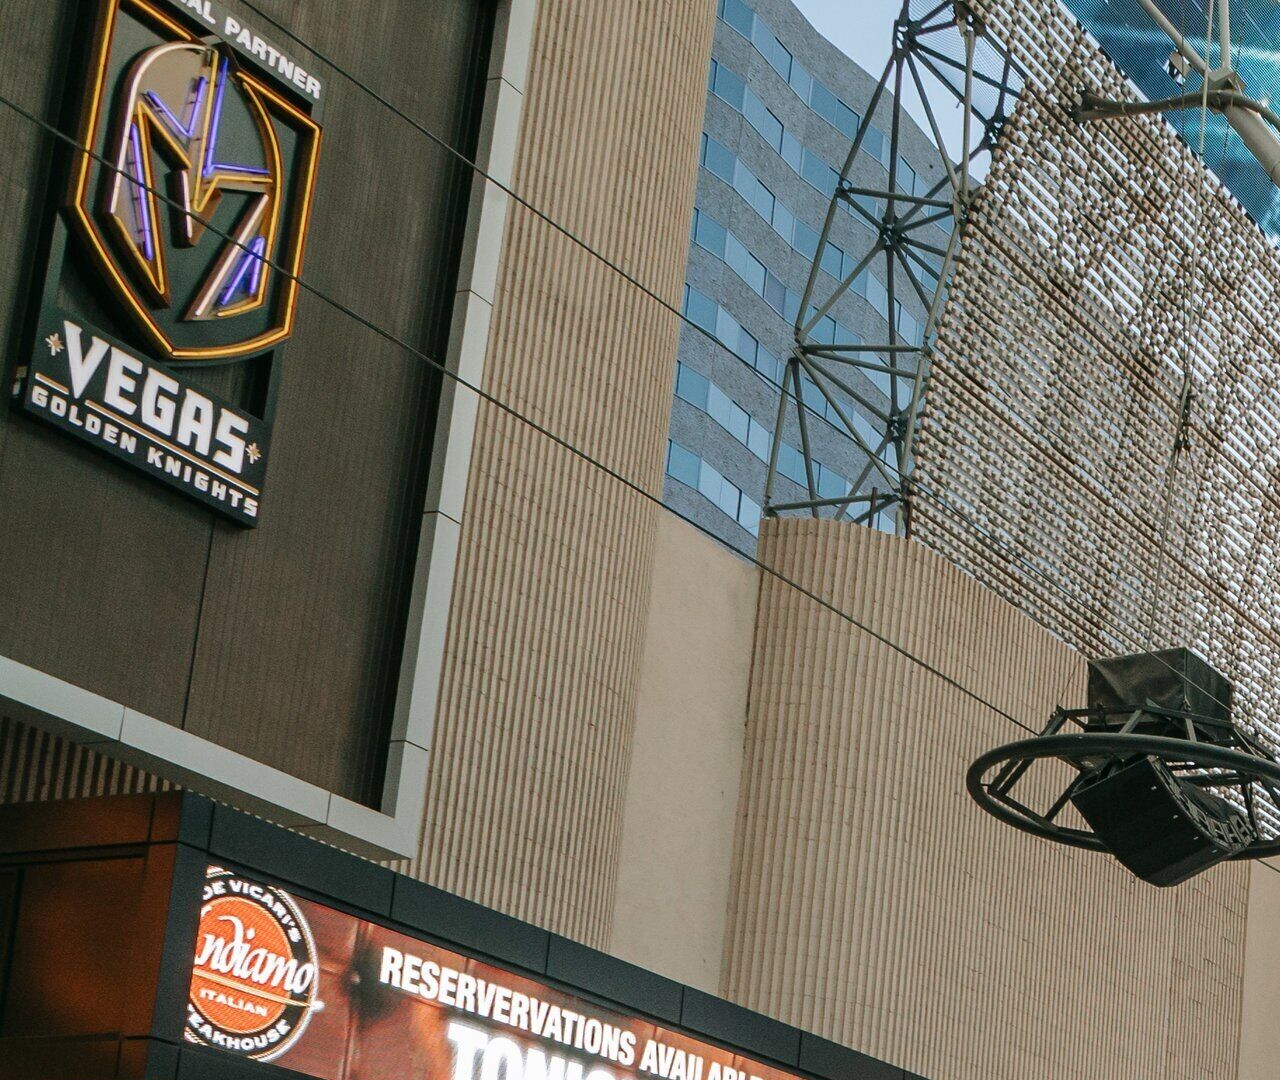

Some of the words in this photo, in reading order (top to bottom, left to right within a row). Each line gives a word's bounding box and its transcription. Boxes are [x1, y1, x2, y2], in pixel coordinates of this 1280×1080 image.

[224, 16, 322, 99] PARTNER
[63, 320, 250, 474] VEGAS
[31, 385, 137, 454] GOLDEN
[147, 446, 258, 518] KNIGHTS
[229, 879, 302, 943] VICARI'S
[200, 989, 269, 1017] ITALIAN
[379, 946, 637, 1067] RESERVERVATIONS
